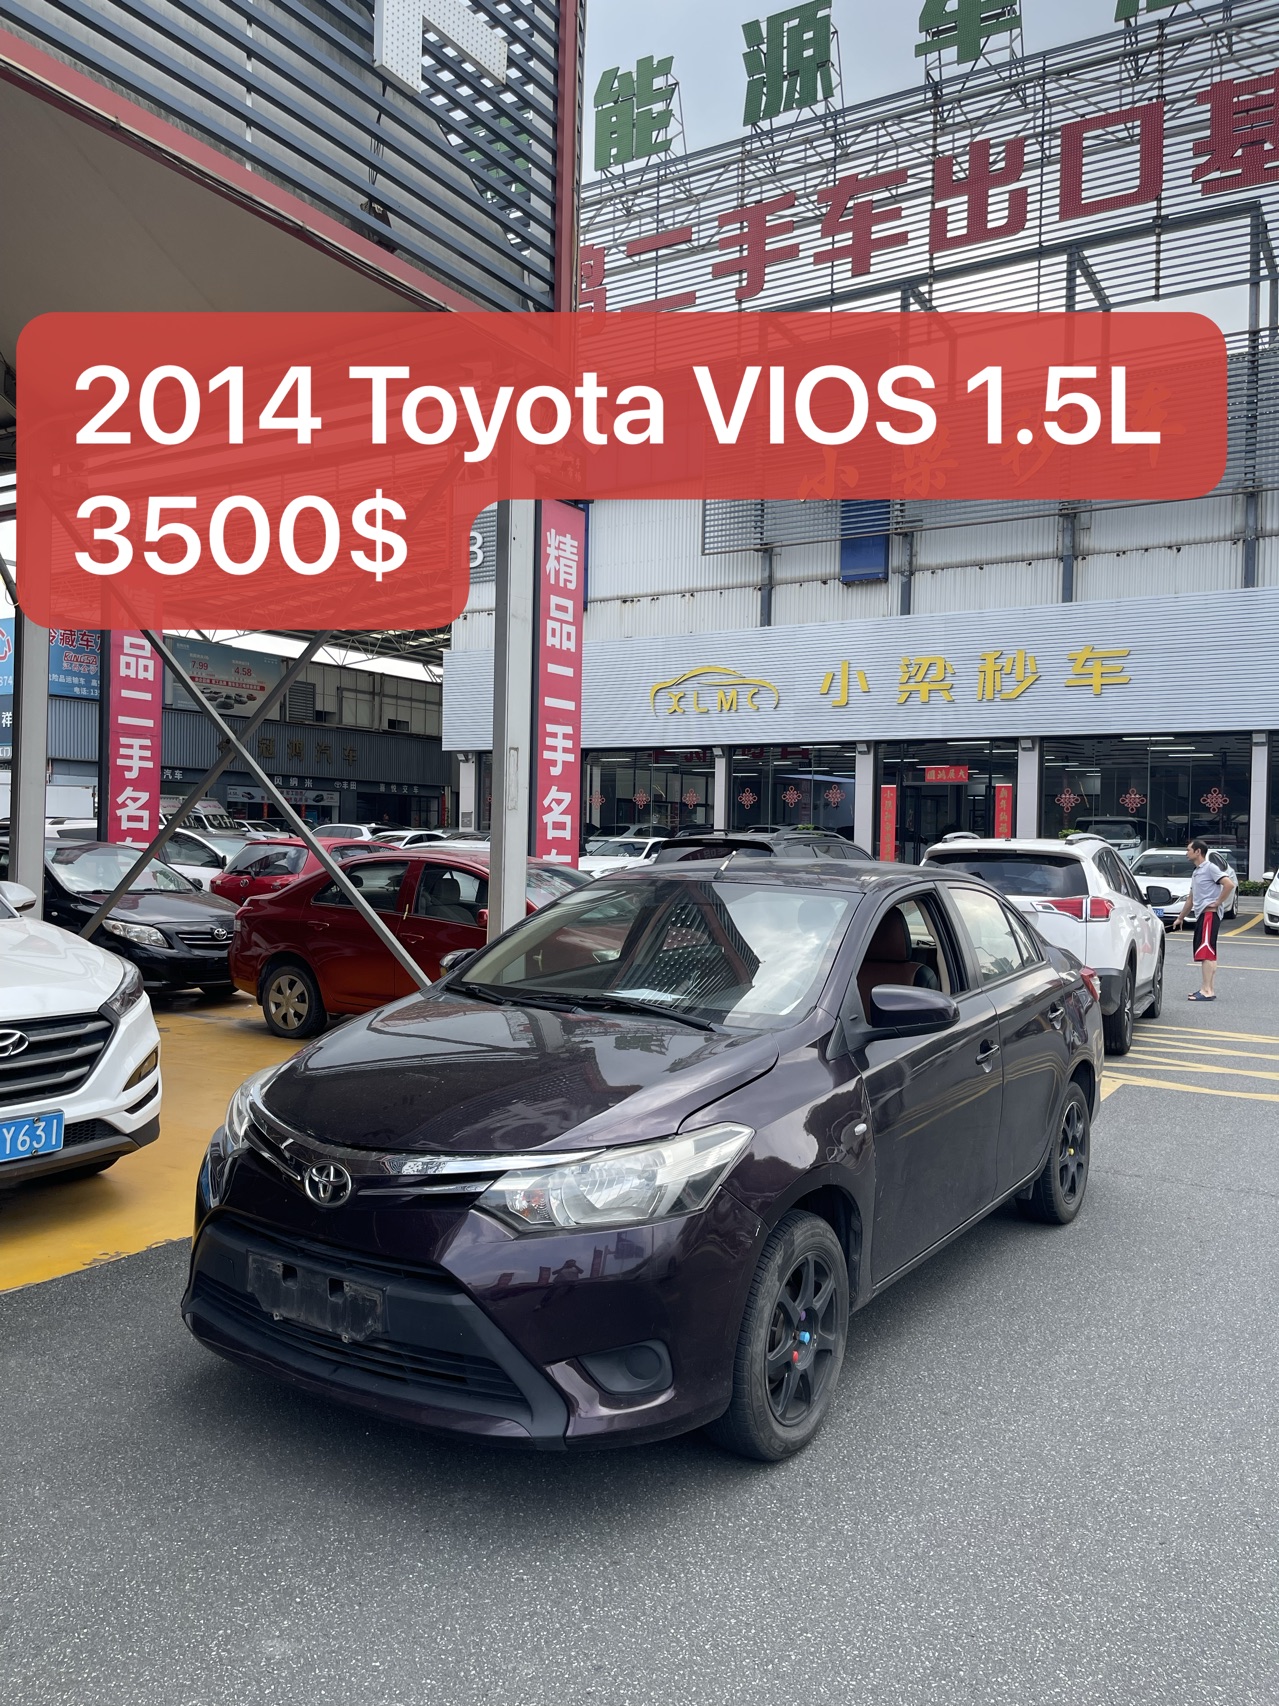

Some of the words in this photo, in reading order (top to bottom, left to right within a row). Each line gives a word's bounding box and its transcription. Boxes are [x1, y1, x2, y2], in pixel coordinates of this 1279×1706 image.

[191, 660, 209, 671] 7.99
[234, 666, 253, 677] 4.58
[820, 645, 1132, 706] 小梁秒车
[543, 528, 578, 864] 精品二手名
[667, 689, 762, 714] XLMC
[116, 636, 154, 849] 品二手名
[163, 768, 184, 780] 汽车
[341, 781, 357, 791] 丰田
[2, 1118, 58, 1155] Y631
